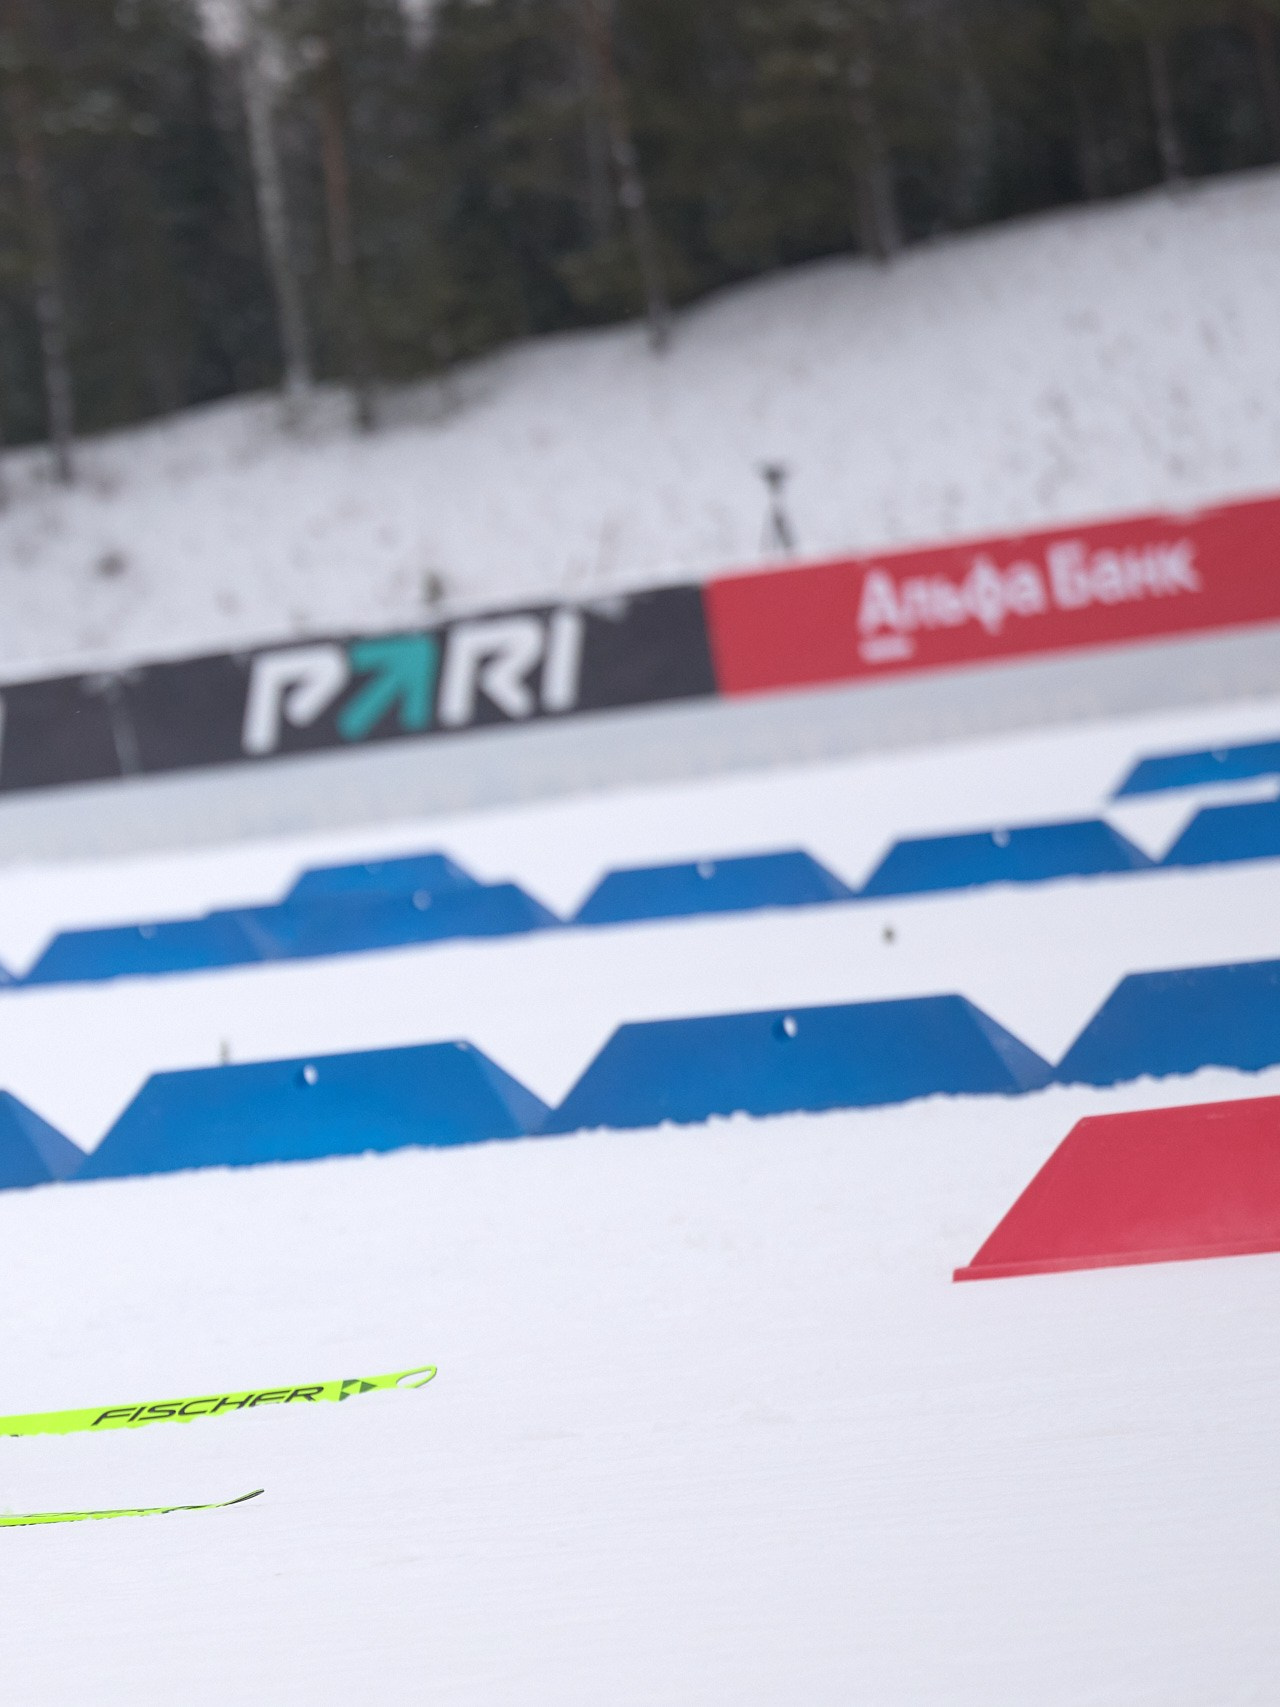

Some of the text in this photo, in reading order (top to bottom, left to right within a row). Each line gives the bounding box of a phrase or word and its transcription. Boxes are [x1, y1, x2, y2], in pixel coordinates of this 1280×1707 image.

[857, 537, 1202, 640] Альфа Банк
[242, 606, 585, 756] PARI
[90, 1386, 324, 1427] FISCHER
